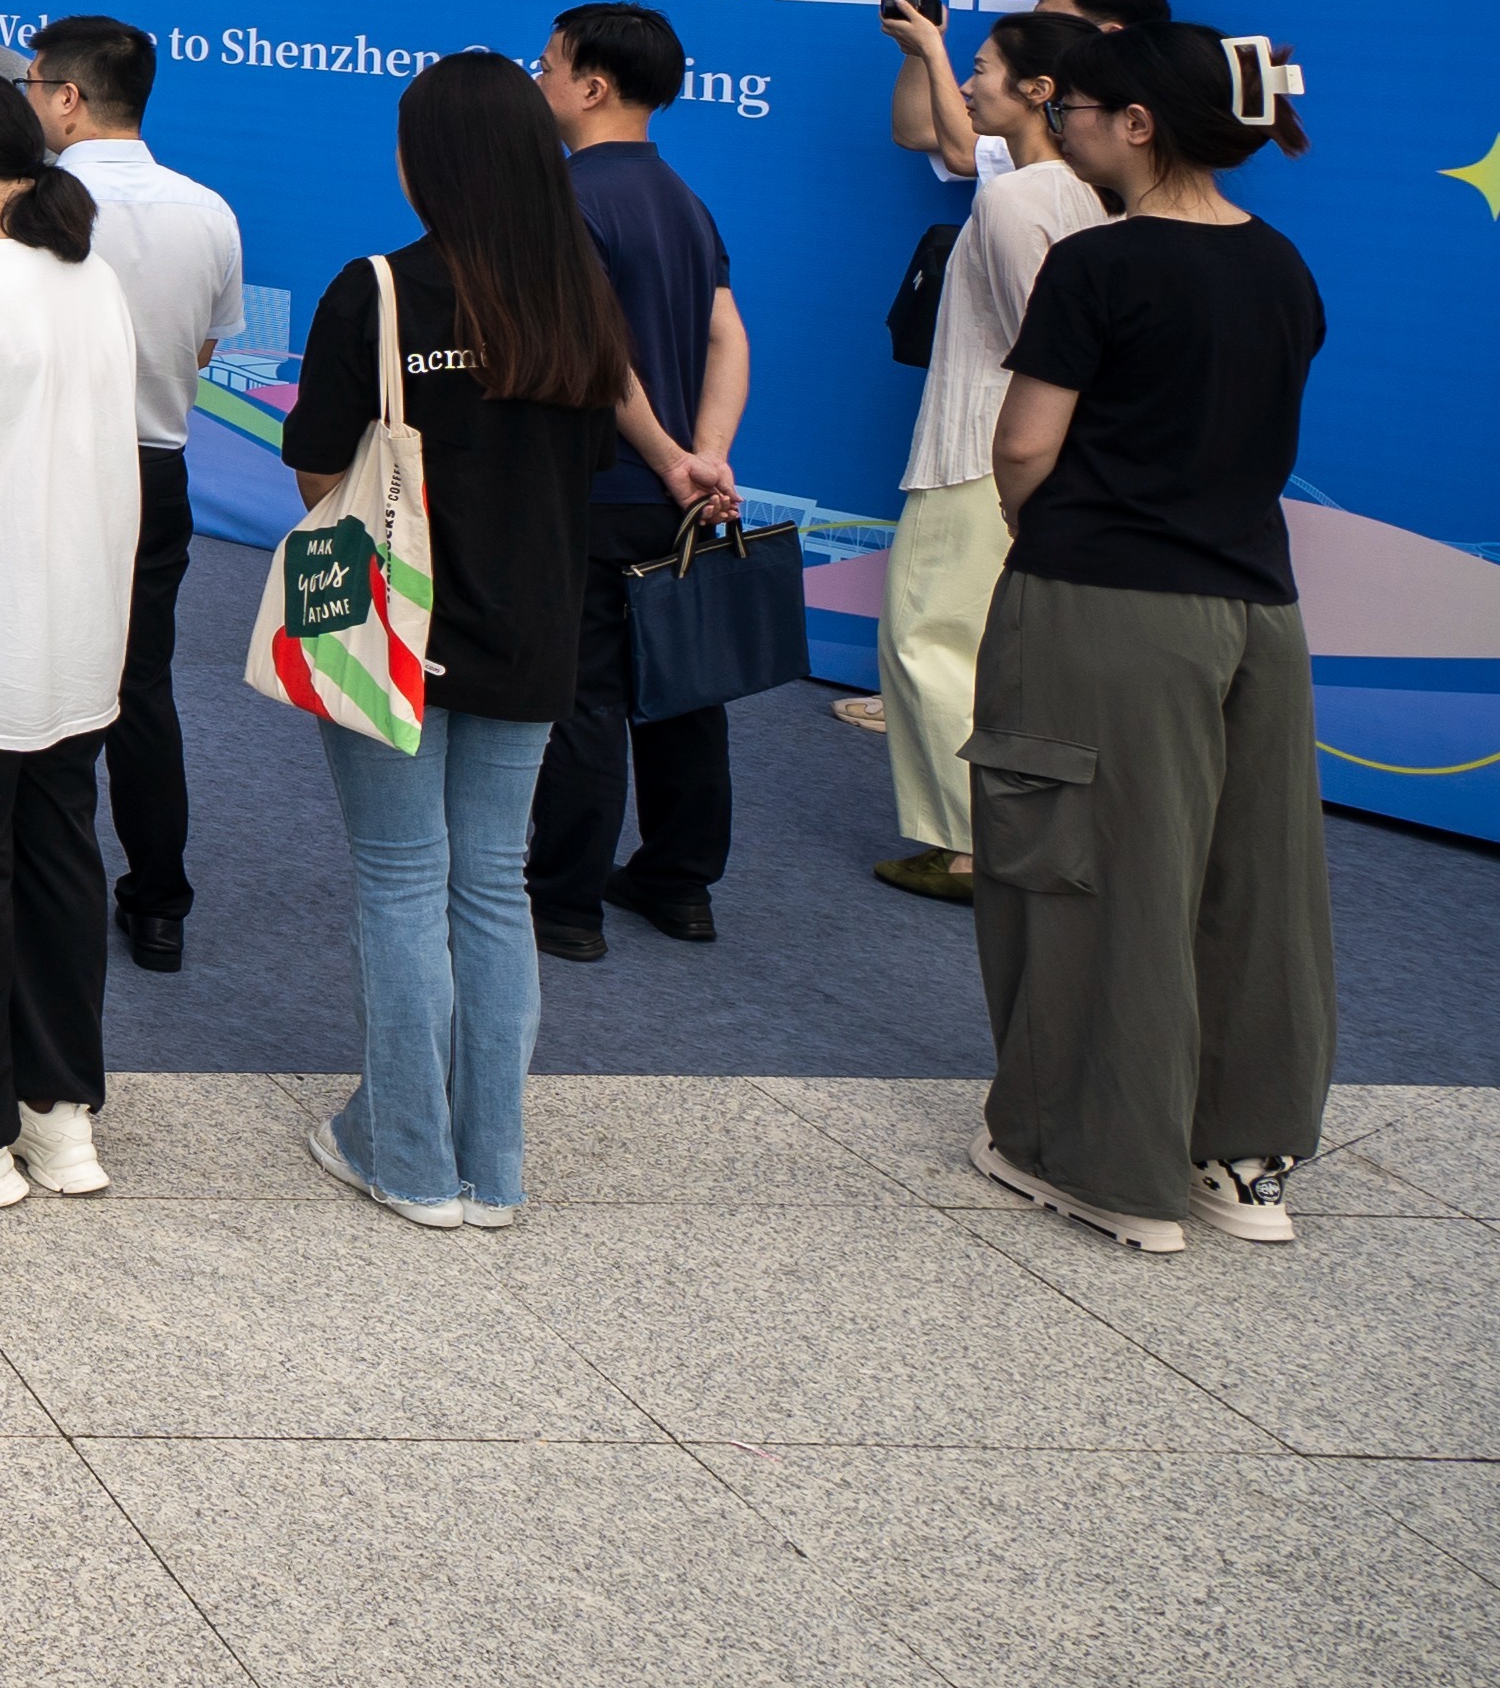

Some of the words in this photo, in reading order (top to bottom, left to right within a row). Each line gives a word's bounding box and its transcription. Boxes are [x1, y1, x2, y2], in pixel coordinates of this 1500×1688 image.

[168, 27, 209, 62] to
[221, 27, 444, 78] Shenzhen
[407, 342, 489, 374] acm
